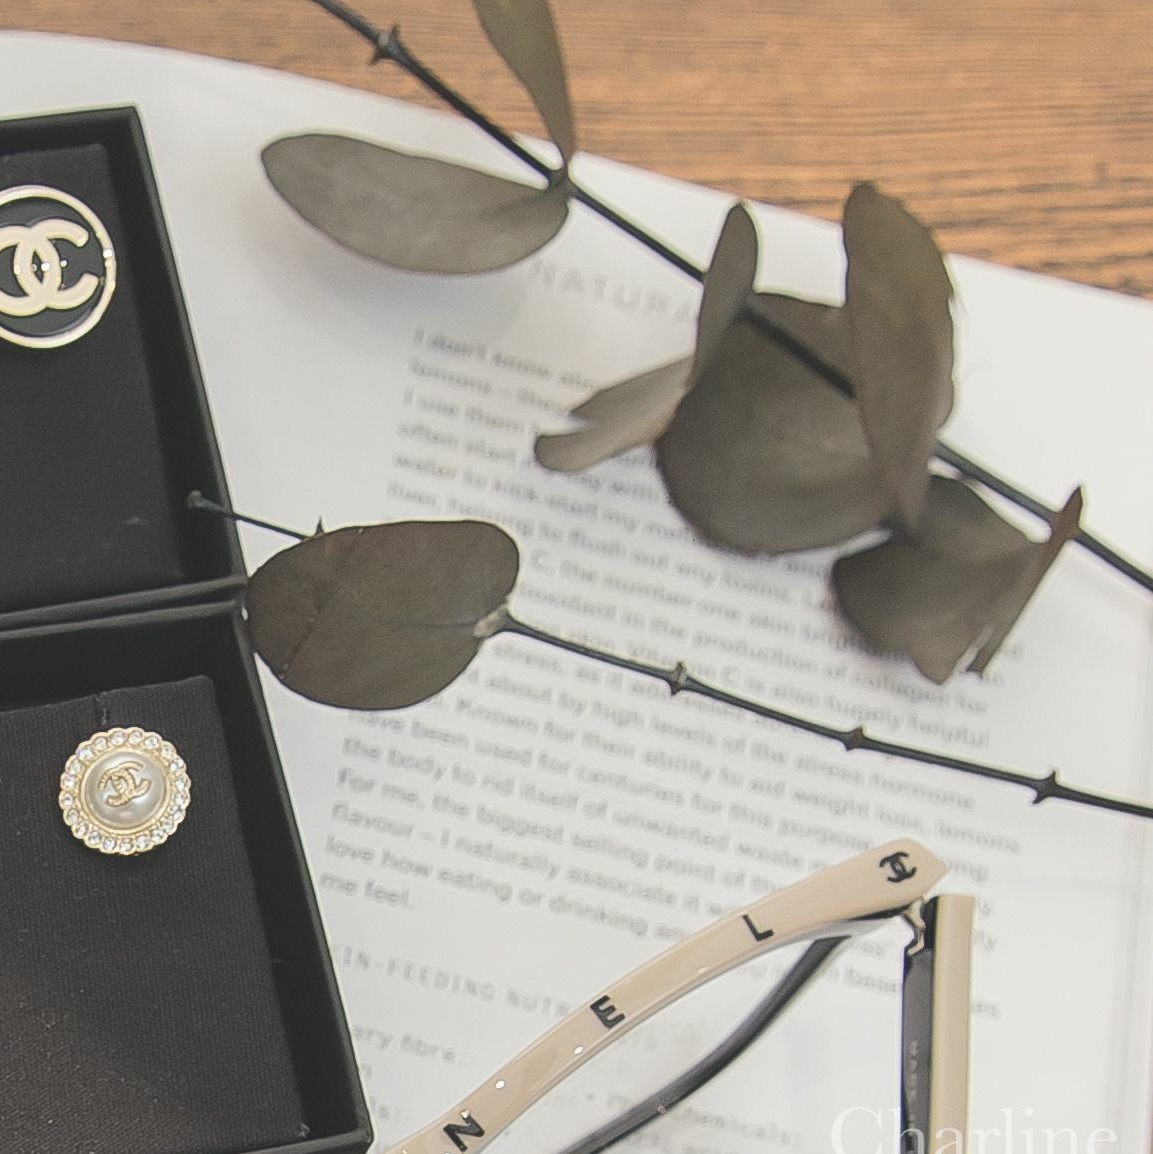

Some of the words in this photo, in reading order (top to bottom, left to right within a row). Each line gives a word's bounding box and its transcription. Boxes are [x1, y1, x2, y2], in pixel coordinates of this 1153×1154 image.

[406, 356, 492, 394] lemons
[428, 330, 488, 360] don't
[491, 348, 549, 378] know
[395, 422, 460, 448] often
[462, 438, 518, 463] start
[419, 397, 461, 417] use
[462, 404, 525, 433] them
[391, 454, 457, 480] water
[460, 468, 490, 489] to
[600, 508, 639, 532] my
[536, 521, 565, 541] to
[566, 528, 628, 558] flush
[628, 549, 671, 569] out
[672, 561, 716, 586] any
[558, 557, 599, 581] the
[745, 611, 795, 634] skin
[619, 608, 648, 629] in
[649, 616, 689, 639] the
[690, 631, 819, 672] production
[822, 662, 847, 679] of
[954, 691, 988, 713] for
[555, 691, 587, 717] by
[647, 715, 717, 747] levels
[719, 737, 745, 753] of
[746, 741, 790, 765] the
[868, 770, 973, 808] hormone
[772, 681, 821, 704] also
[906, 713, 991, 748] helpful
[340, 736, 383, 761] the
[385, 748, 444, 781] body
[449, 765, 477, 785] to
[478, 775, 515, 795] rid
[516, 782, 578, 811] itself
[580, 801, 609, 819] of
[610, 810, 731, 849] unwanted
[731, 840, 805, 868] waste
[408, 720, 468, 749] been
[470, 741, 533, 766] used
[535, 753, 571, 776] for
[689, 792, 726, 815] for
[455, 696, 540, 733] Known
[540, 720, 576, 743] for
[639, 749, 714, 783] ability
[716, 766, 745, 786] to
[786, 788, 871, 817] weight
[930, 818, 1024, 853] lemons
[329, 801, 413, 837] flavour
[452, 838, 561, 879] naturally
[565, 866, 681, 904] associate
[335, 768, 374, 792] For
[378, 785, 427, 810] me,
[428, 795, 470, 819] the
[472, 806, 564, 843] biggest
[569, 835, 649, 868] selling
[650, 855, 718, 879] point
[719, 869, 747, 886] of
[319, 874, 360, 894] me
[361, 880, 414, 907] feel.
[324, 836, 376, 863] love
[378, 850, 432, 877] how
[435, 868, 514, 902] eating
[515, 889, 544, 905] or
[546, 892, 649, 937] drinking
[338, 946, 497, 1001] IN-FEEDING
[398, 1030, 466, 1067] fibre:
